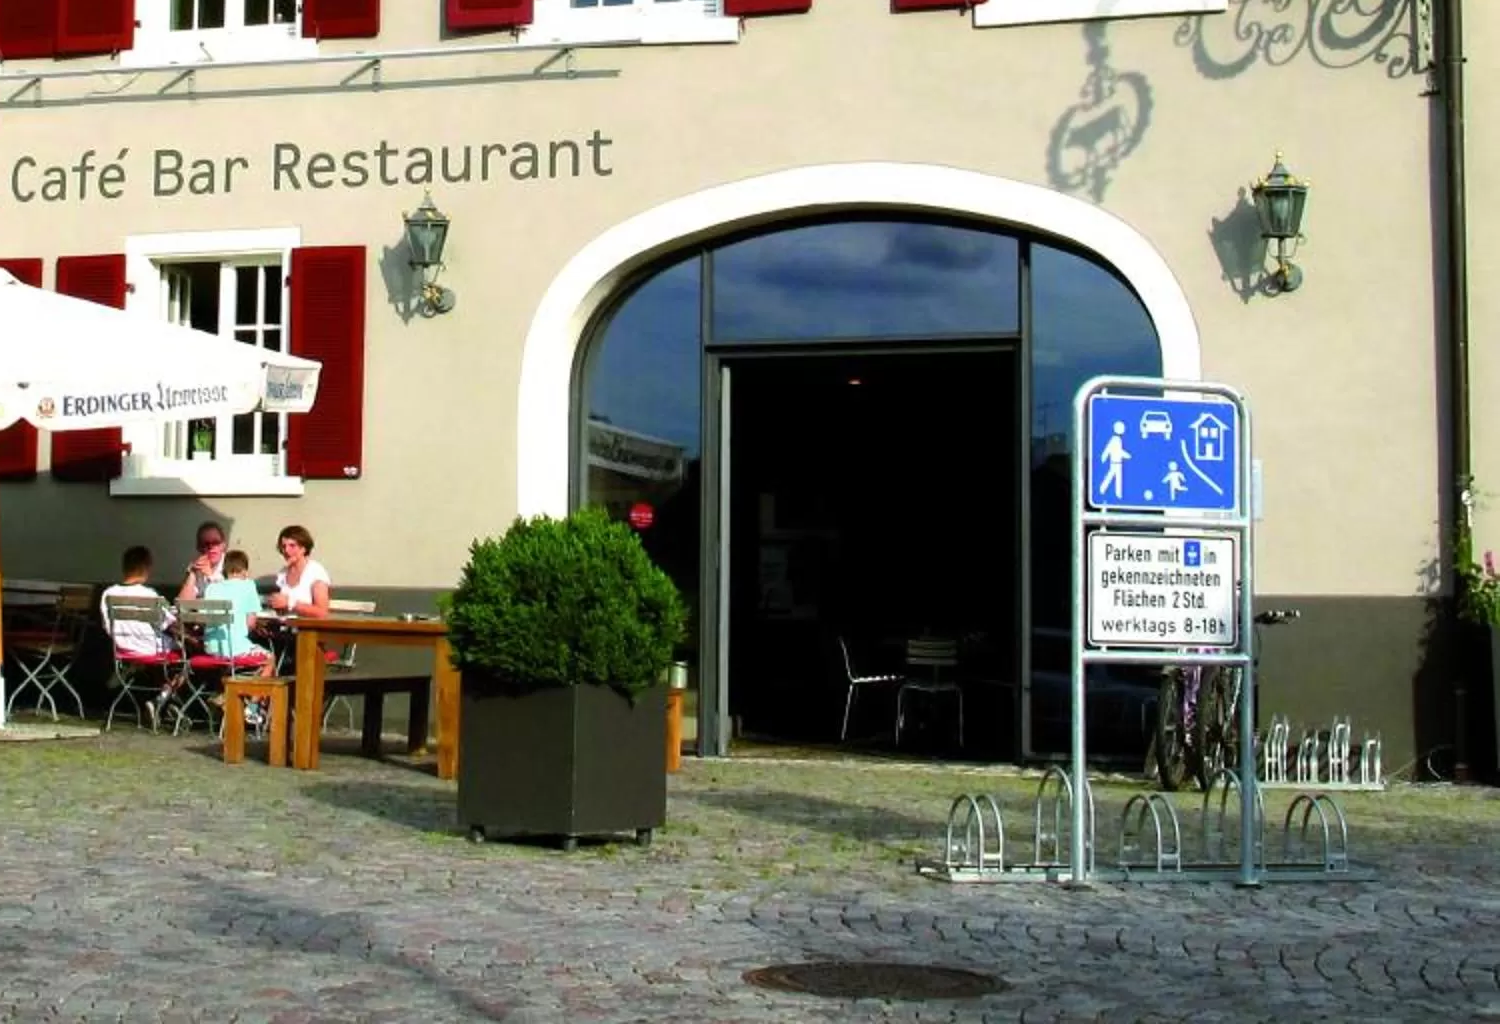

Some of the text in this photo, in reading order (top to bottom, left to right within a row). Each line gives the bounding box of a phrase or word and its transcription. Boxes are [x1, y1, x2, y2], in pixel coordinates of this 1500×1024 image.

[10, 147, 129, 203] Café
[152, 148, 250, 197] Bar
[272, 128, 614, 191] Restaurant
[62, 391, 153, 417] ERDINGER
[1104, 543, 1218, 565] Parken mit in
[1100, 566, 1222, 589] gekennzeichneten
[1112, 588, 1167, 608] Flächen
[1100, 616, 1178, 637] werktags
